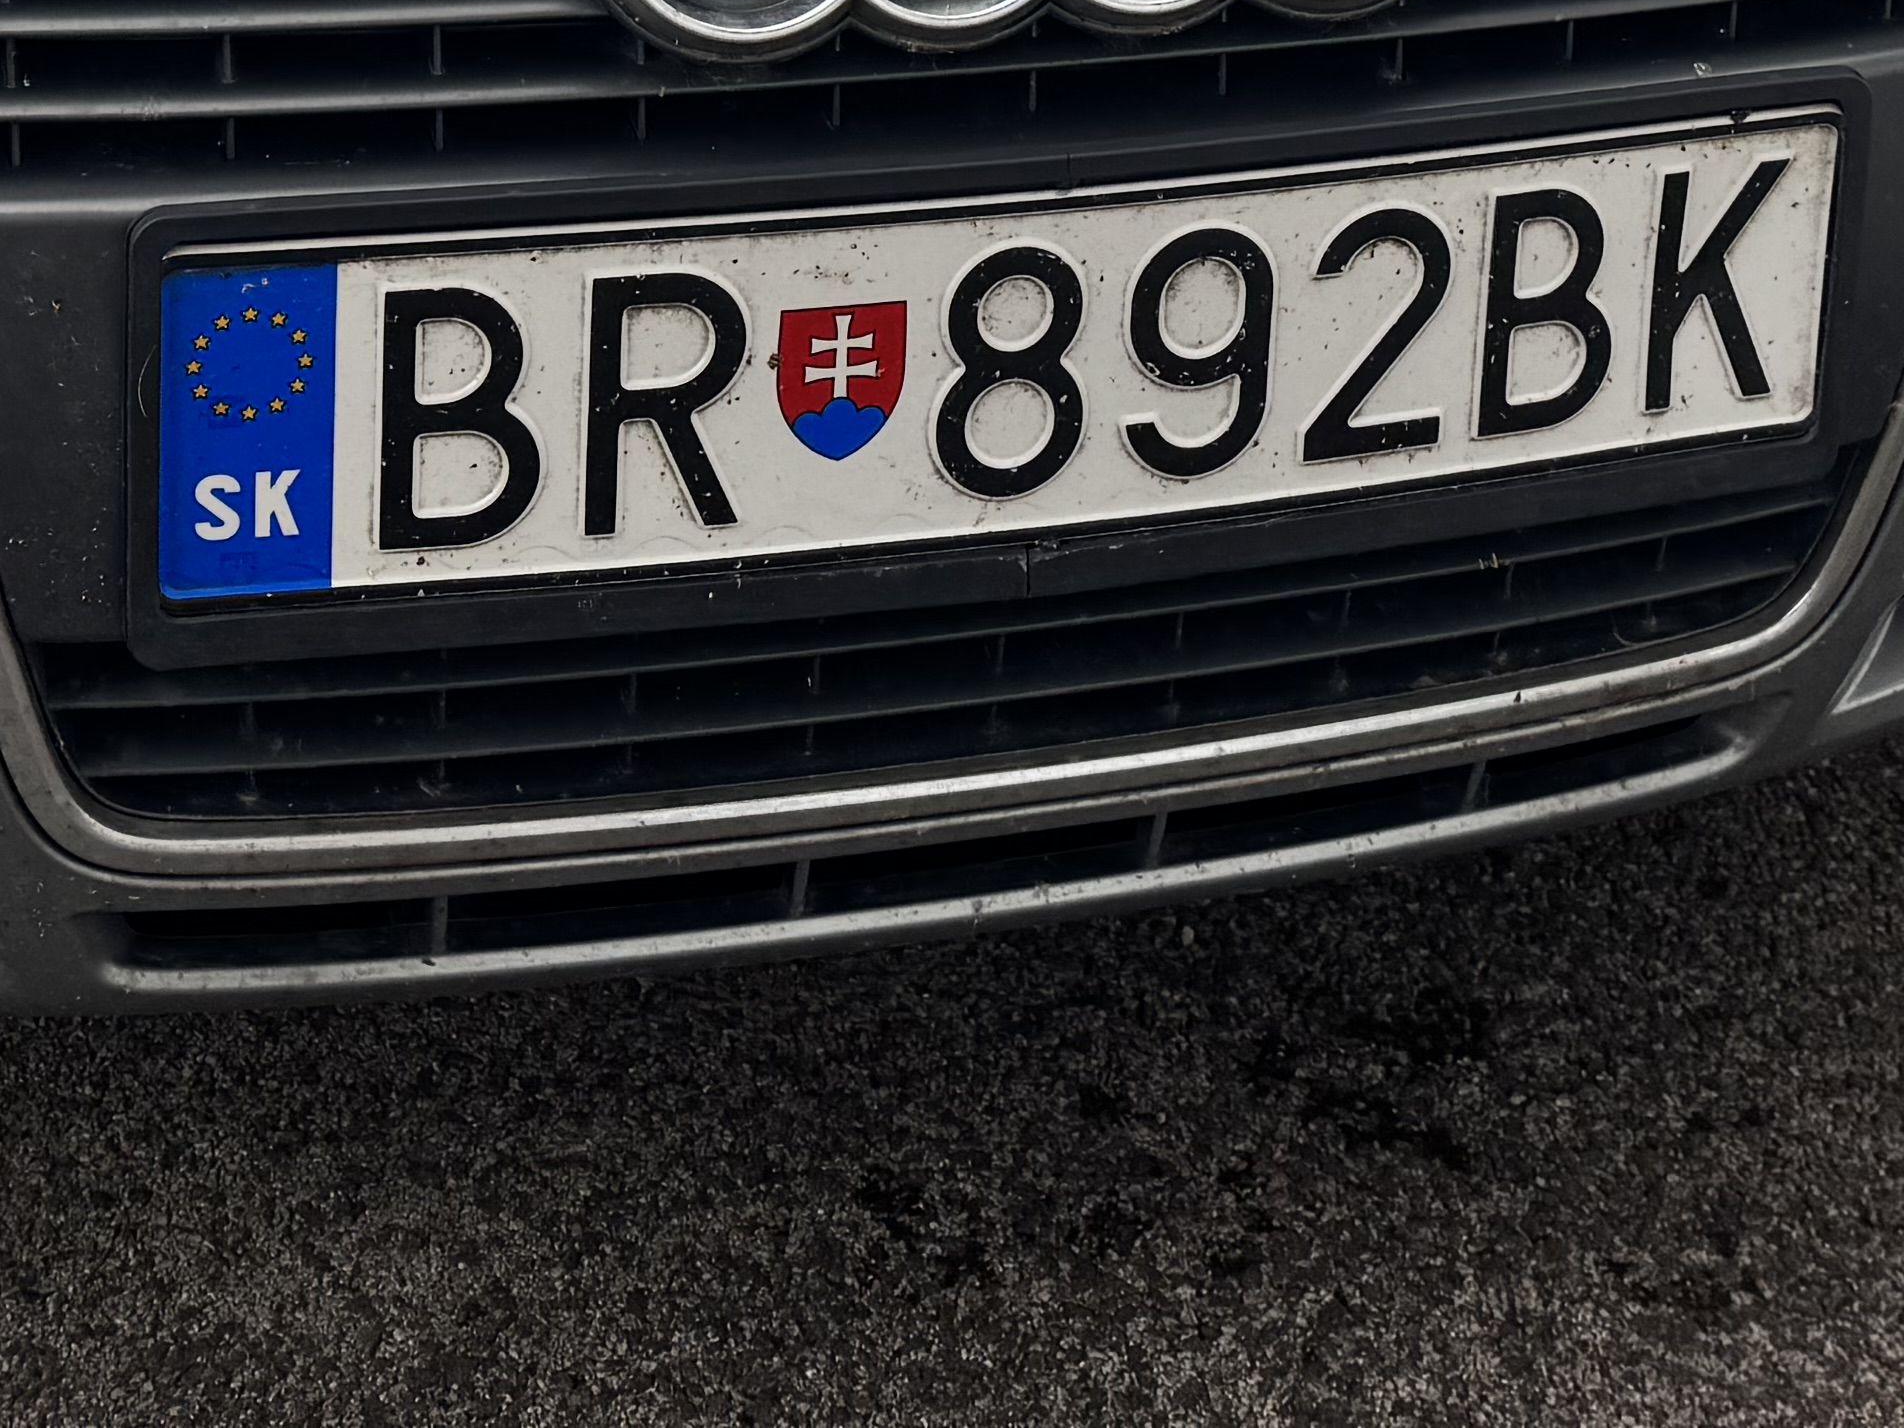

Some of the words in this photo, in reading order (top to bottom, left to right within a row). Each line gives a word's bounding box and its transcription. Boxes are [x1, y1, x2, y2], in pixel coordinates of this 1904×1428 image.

[379, 273, 748, 550] BR
[942, 158, 1790, 499] 892BK
[194, 468, 302, 542] SK
